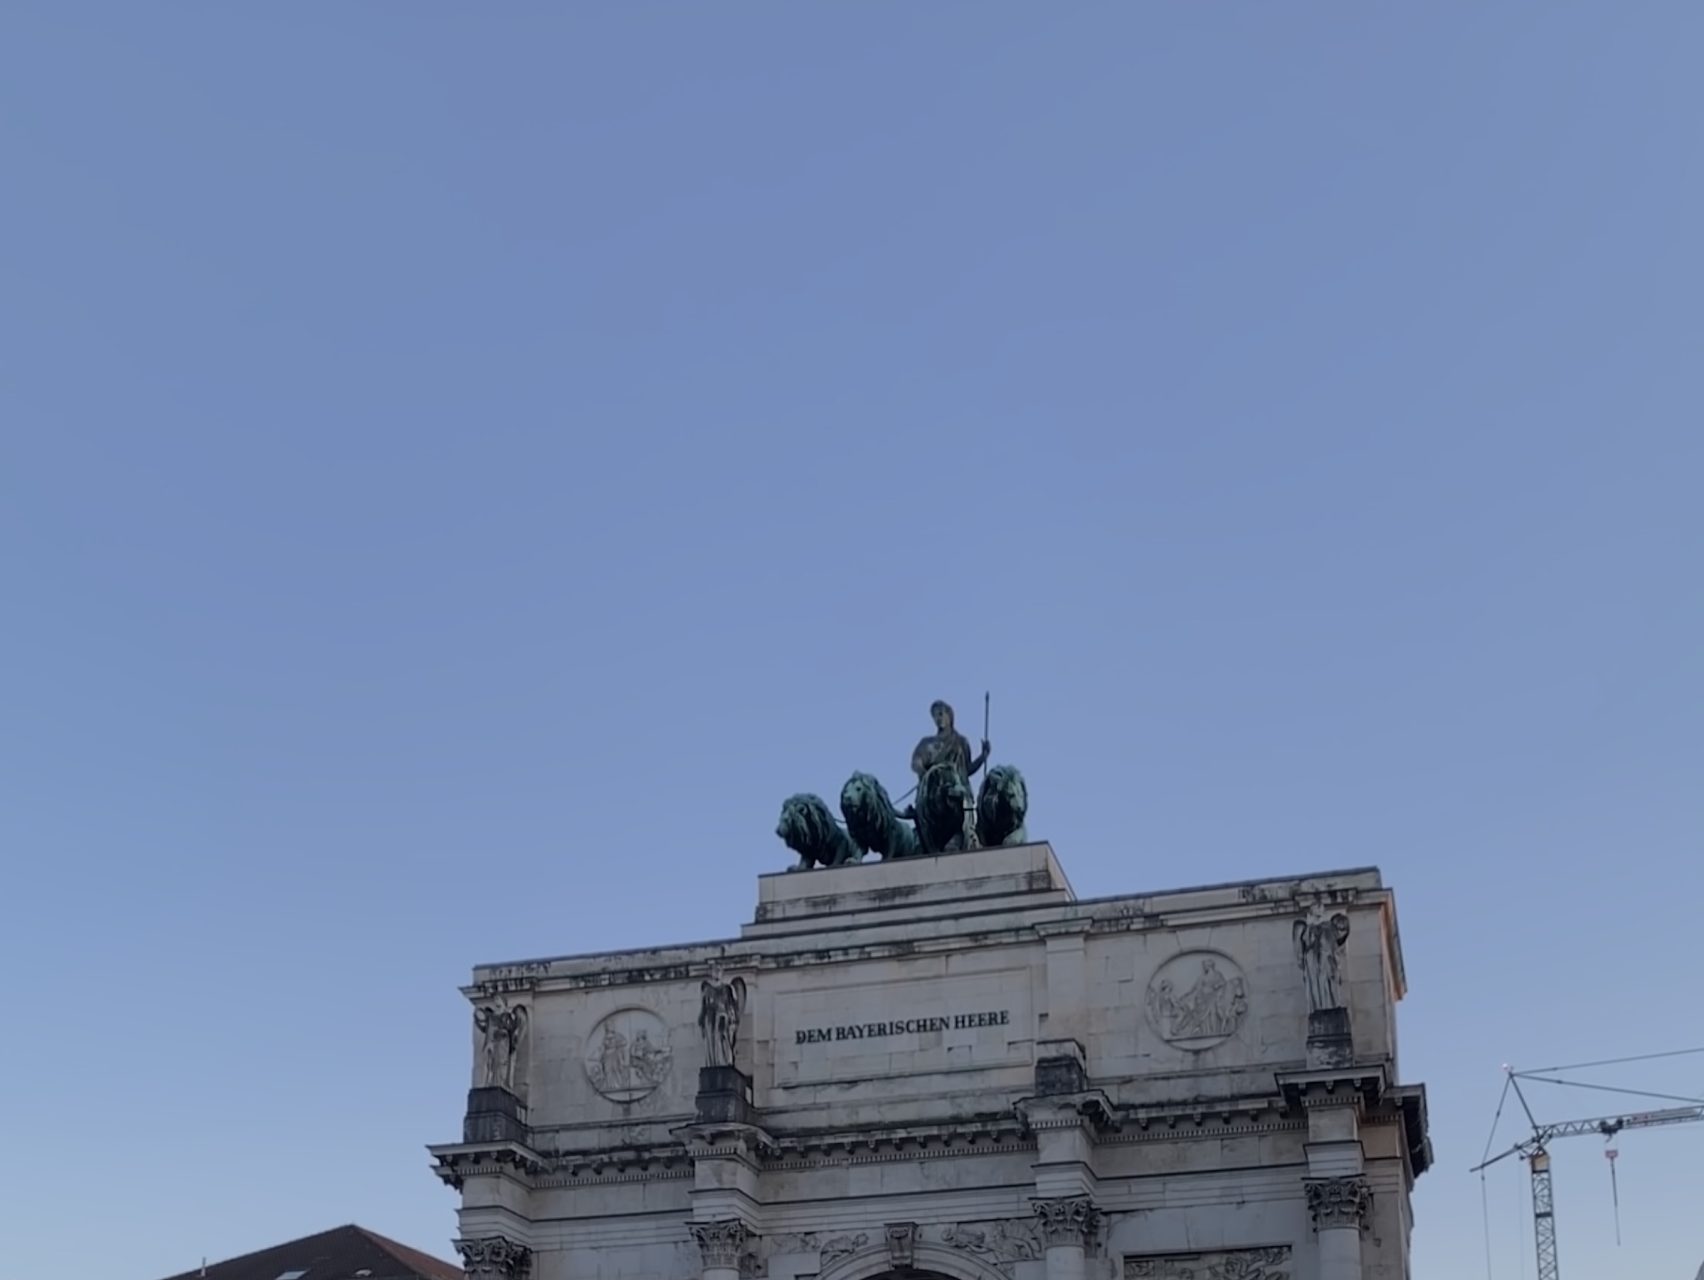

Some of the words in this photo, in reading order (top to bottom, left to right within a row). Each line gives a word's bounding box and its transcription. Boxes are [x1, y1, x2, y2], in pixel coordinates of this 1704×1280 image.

[795, 1029, 832, 1044] DEM
[836, 1016, 949, 1041] BAYERISCHEN
[954, 1010, 1009, 1030] HEERE
